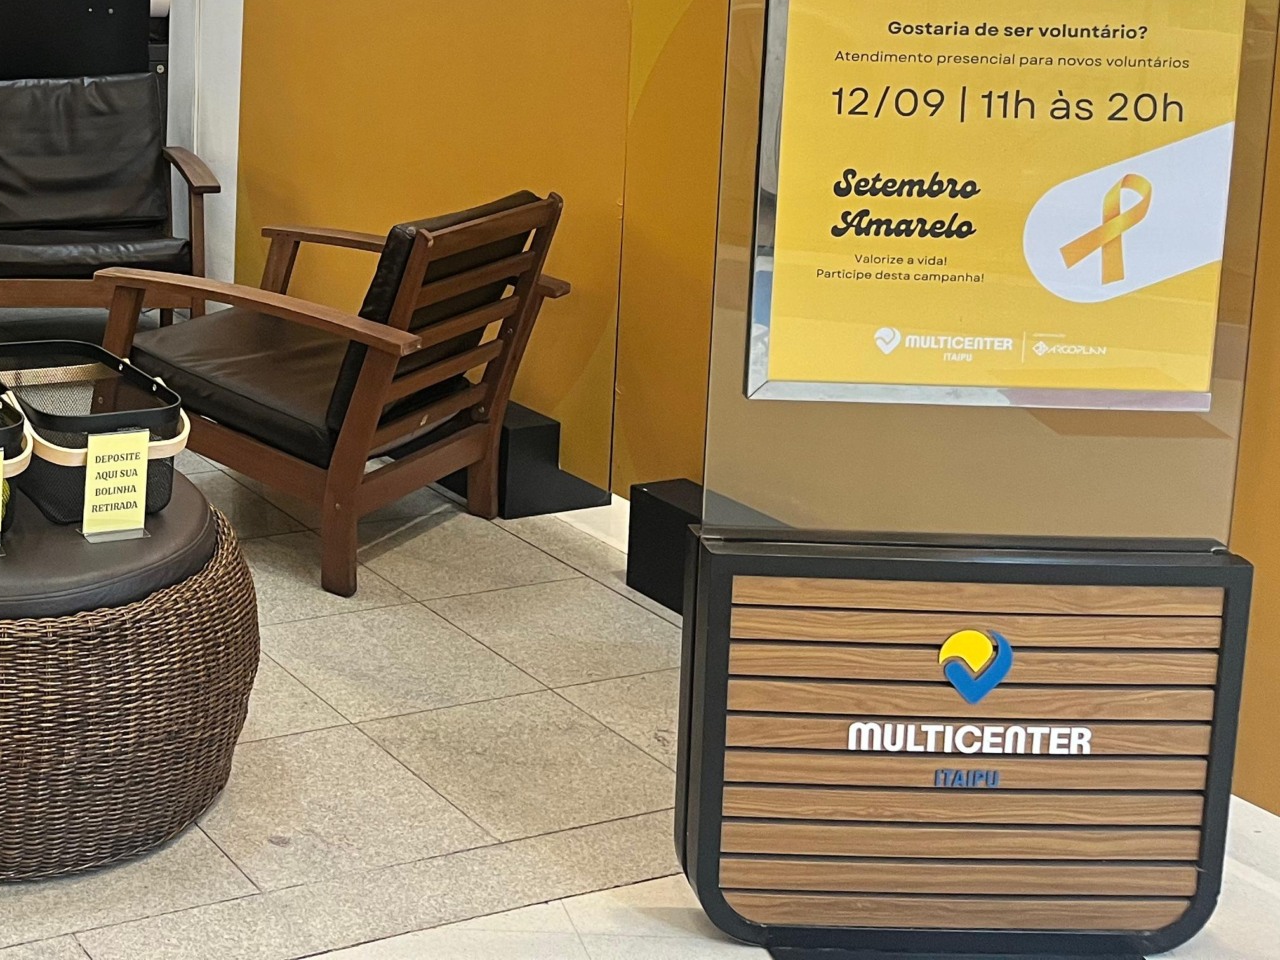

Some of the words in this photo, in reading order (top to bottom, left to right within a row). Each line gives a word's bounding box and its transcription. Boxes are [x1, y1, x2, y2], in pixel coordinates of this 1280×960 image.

[888, 21, 970, 37] Gostaria
[975, 22, 999, 37] de
[1005, 25, 1032, 37] ser
[1038, 24, 1148, 40] voluntário?
[834, 51, 933, 64] Atendimento
[937, 52, 1015, 68] presencial
[1020, 55, 1053, 69] para
[1057, 57, 1102, 67] novos
[1106, 56, 1190, 69] voluntários
[832, 87, 945, 117] 12/09
[981, 91, 1035, 119] 11h
[1050, 91, 1093, 121] às
[1107, 92, 1183, 123] 20h
[833, 168, 980, 199] Setembro
[831, 209, 976, 239] Amarelo
[855, 254, 903, 266] Valorize
[907, 258, 913, 266] a
[917, 255, 948, 267] vida!
[816, 269, 871, 283] Participe
[875, 270, 910, 282] desta
[914, 272, 984, 285] campanha!
[905, 335, 1013, 350] MULTICENTER
[943, 353, 972, 362] ITAIPU
[95, 452, 141, 464] DEPOSITE
[95, 470, 118, 480] AQUI
[119, 469, 138, 478] SUA
[95, 485, 137, 497] BOLINHA
[91, 501, 138, 512] RETIRADA
[848, 722, 1092, 755] MULTICENTER
[935, 769, 999, 788] ITAIPU
